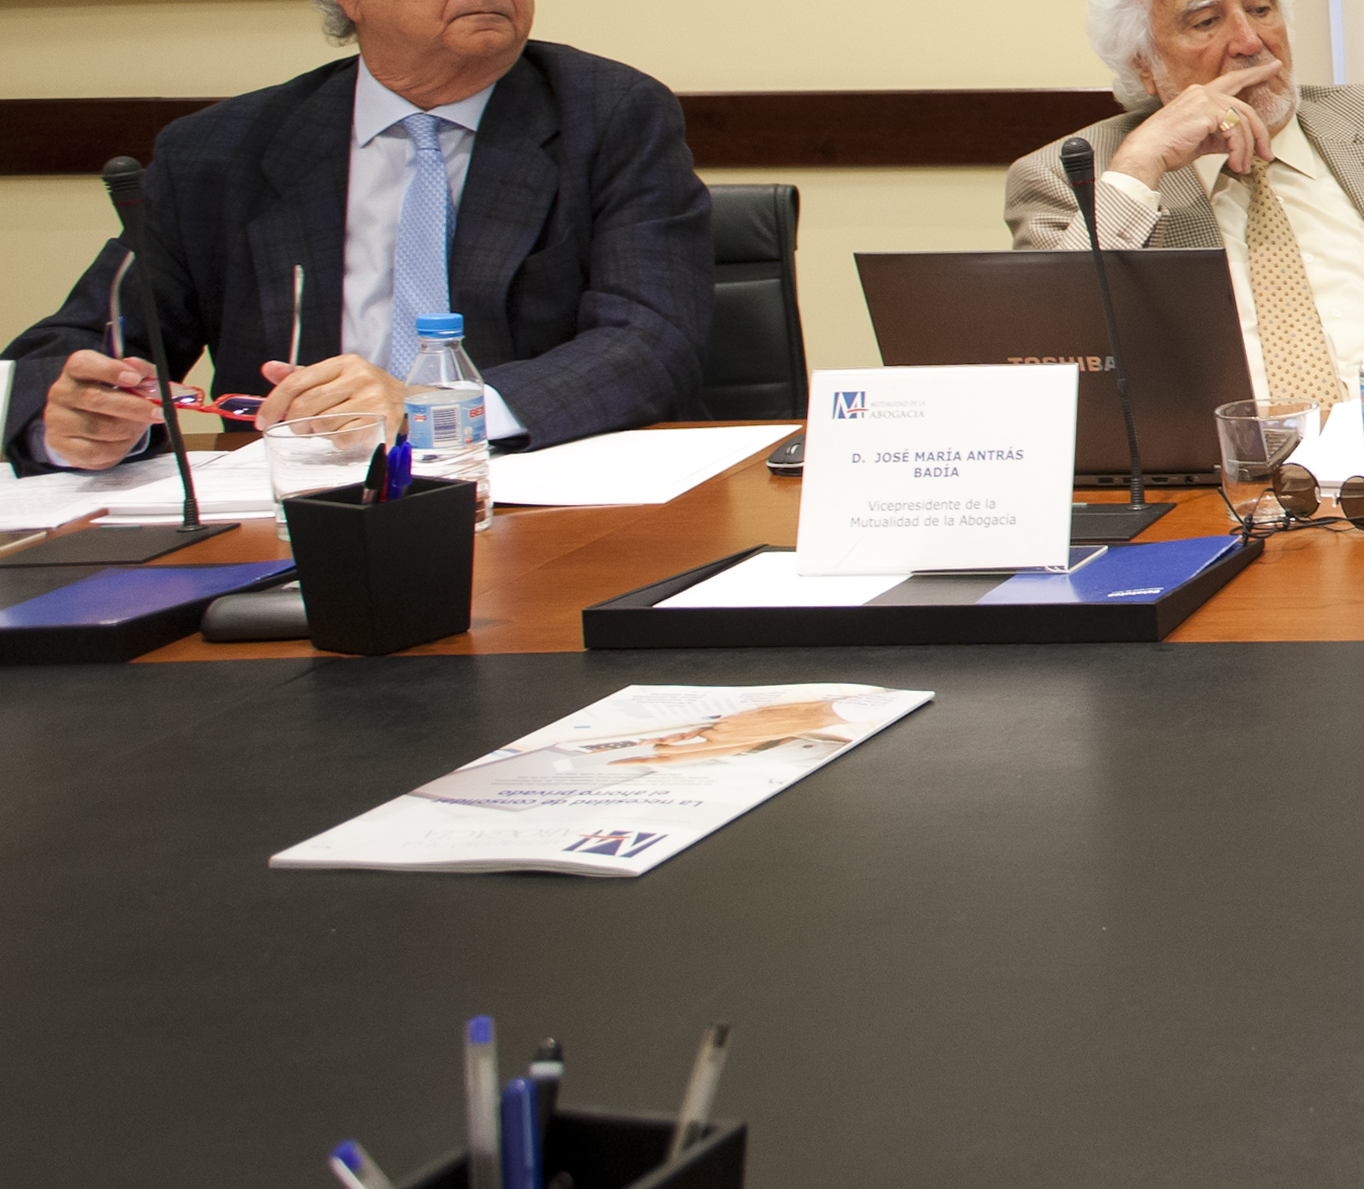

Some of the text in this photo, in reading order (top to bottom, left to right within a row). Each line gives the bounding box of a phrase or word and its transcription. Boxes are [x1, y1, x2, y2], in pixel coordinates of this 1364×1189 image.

[852, 446, 1024, 463] D. JOSÉ MARÍA ANTRÁS
[914, 463, 960, 478] BADÍA
[868, 498, 996, 513] Vicepresidente de la
[850, 513, 1017, 528] Mutualidad de la Abogacía
